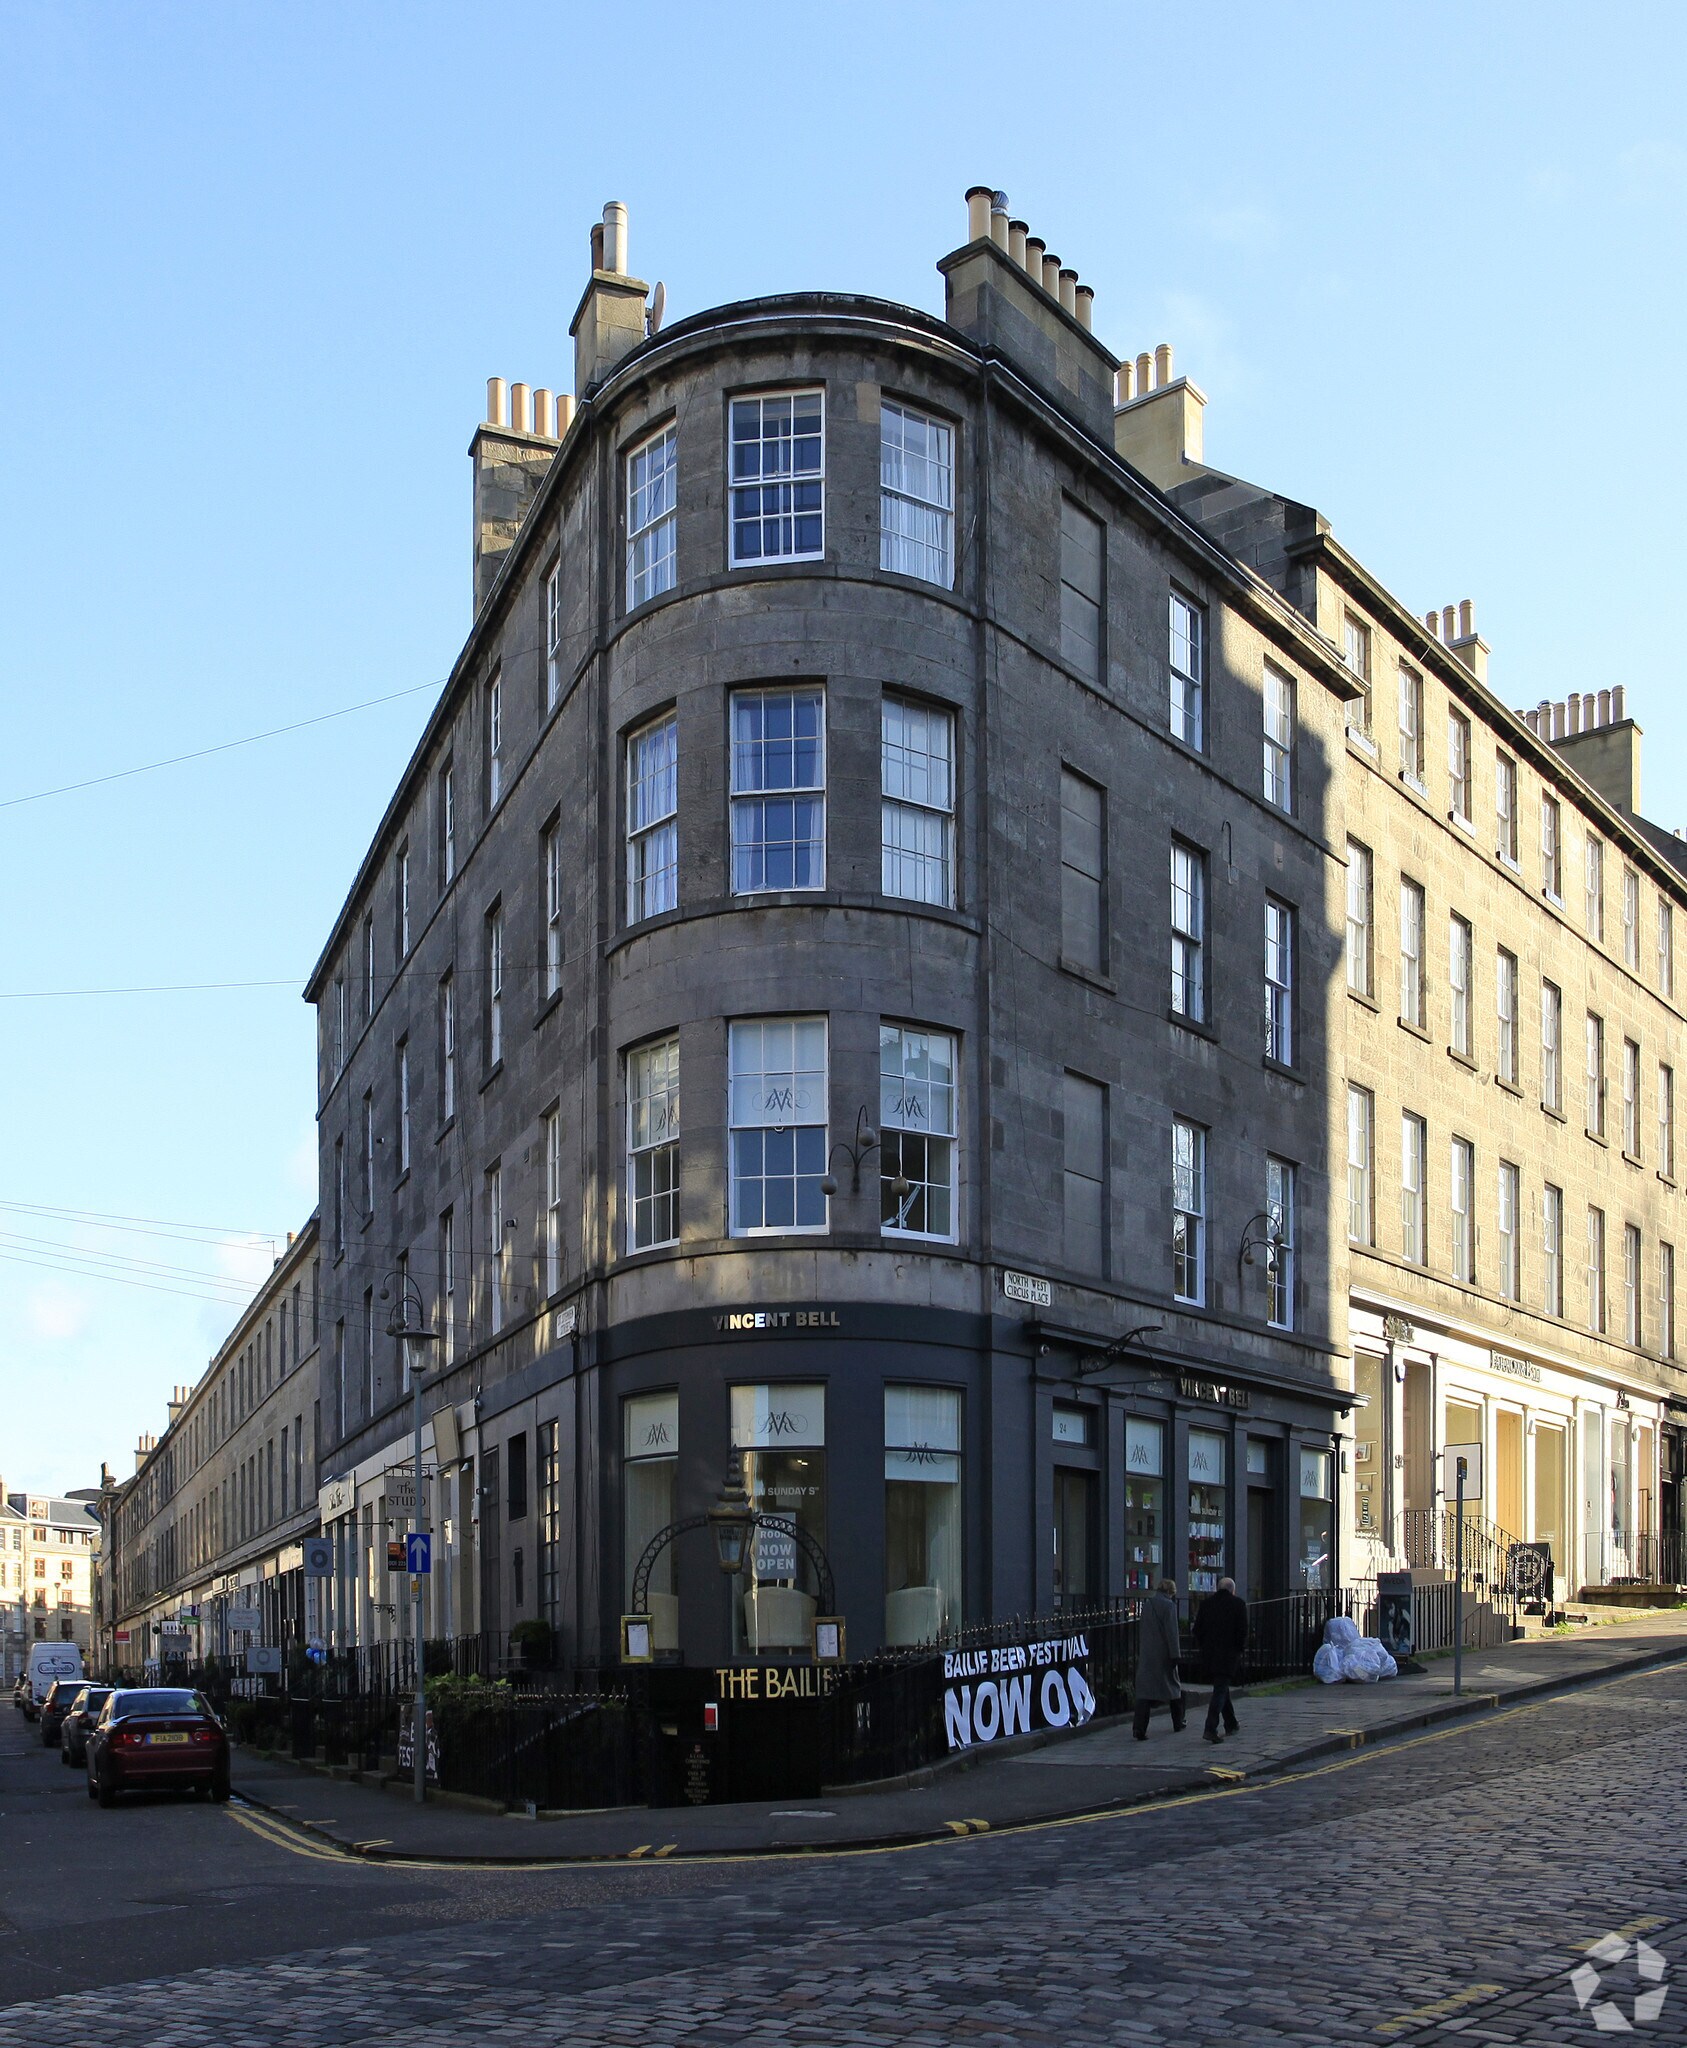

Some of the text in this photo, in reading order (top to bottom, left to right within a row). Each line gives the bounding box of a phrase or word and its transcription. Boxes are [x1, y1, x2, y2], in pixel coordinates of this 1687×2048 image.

[1008, 1273, 1047, 1292] NORTH WEST
[1007, 1284, 1049, 1304] CIRCUS PLACE
[713, 1311, 840, 1330] VINCENT BELL
[1180, 1377, 1227, 1403] VINCENT
[759, 1544, 792, 1556] NOW
[756, 1558, 794, 1570] OPEN
[944, 1634, 1090, 1678] BAILIE BEER FESTIVAL
[716, 1668, 759, 1699] THE
[944, 1674, 1032, 1748] NOW
